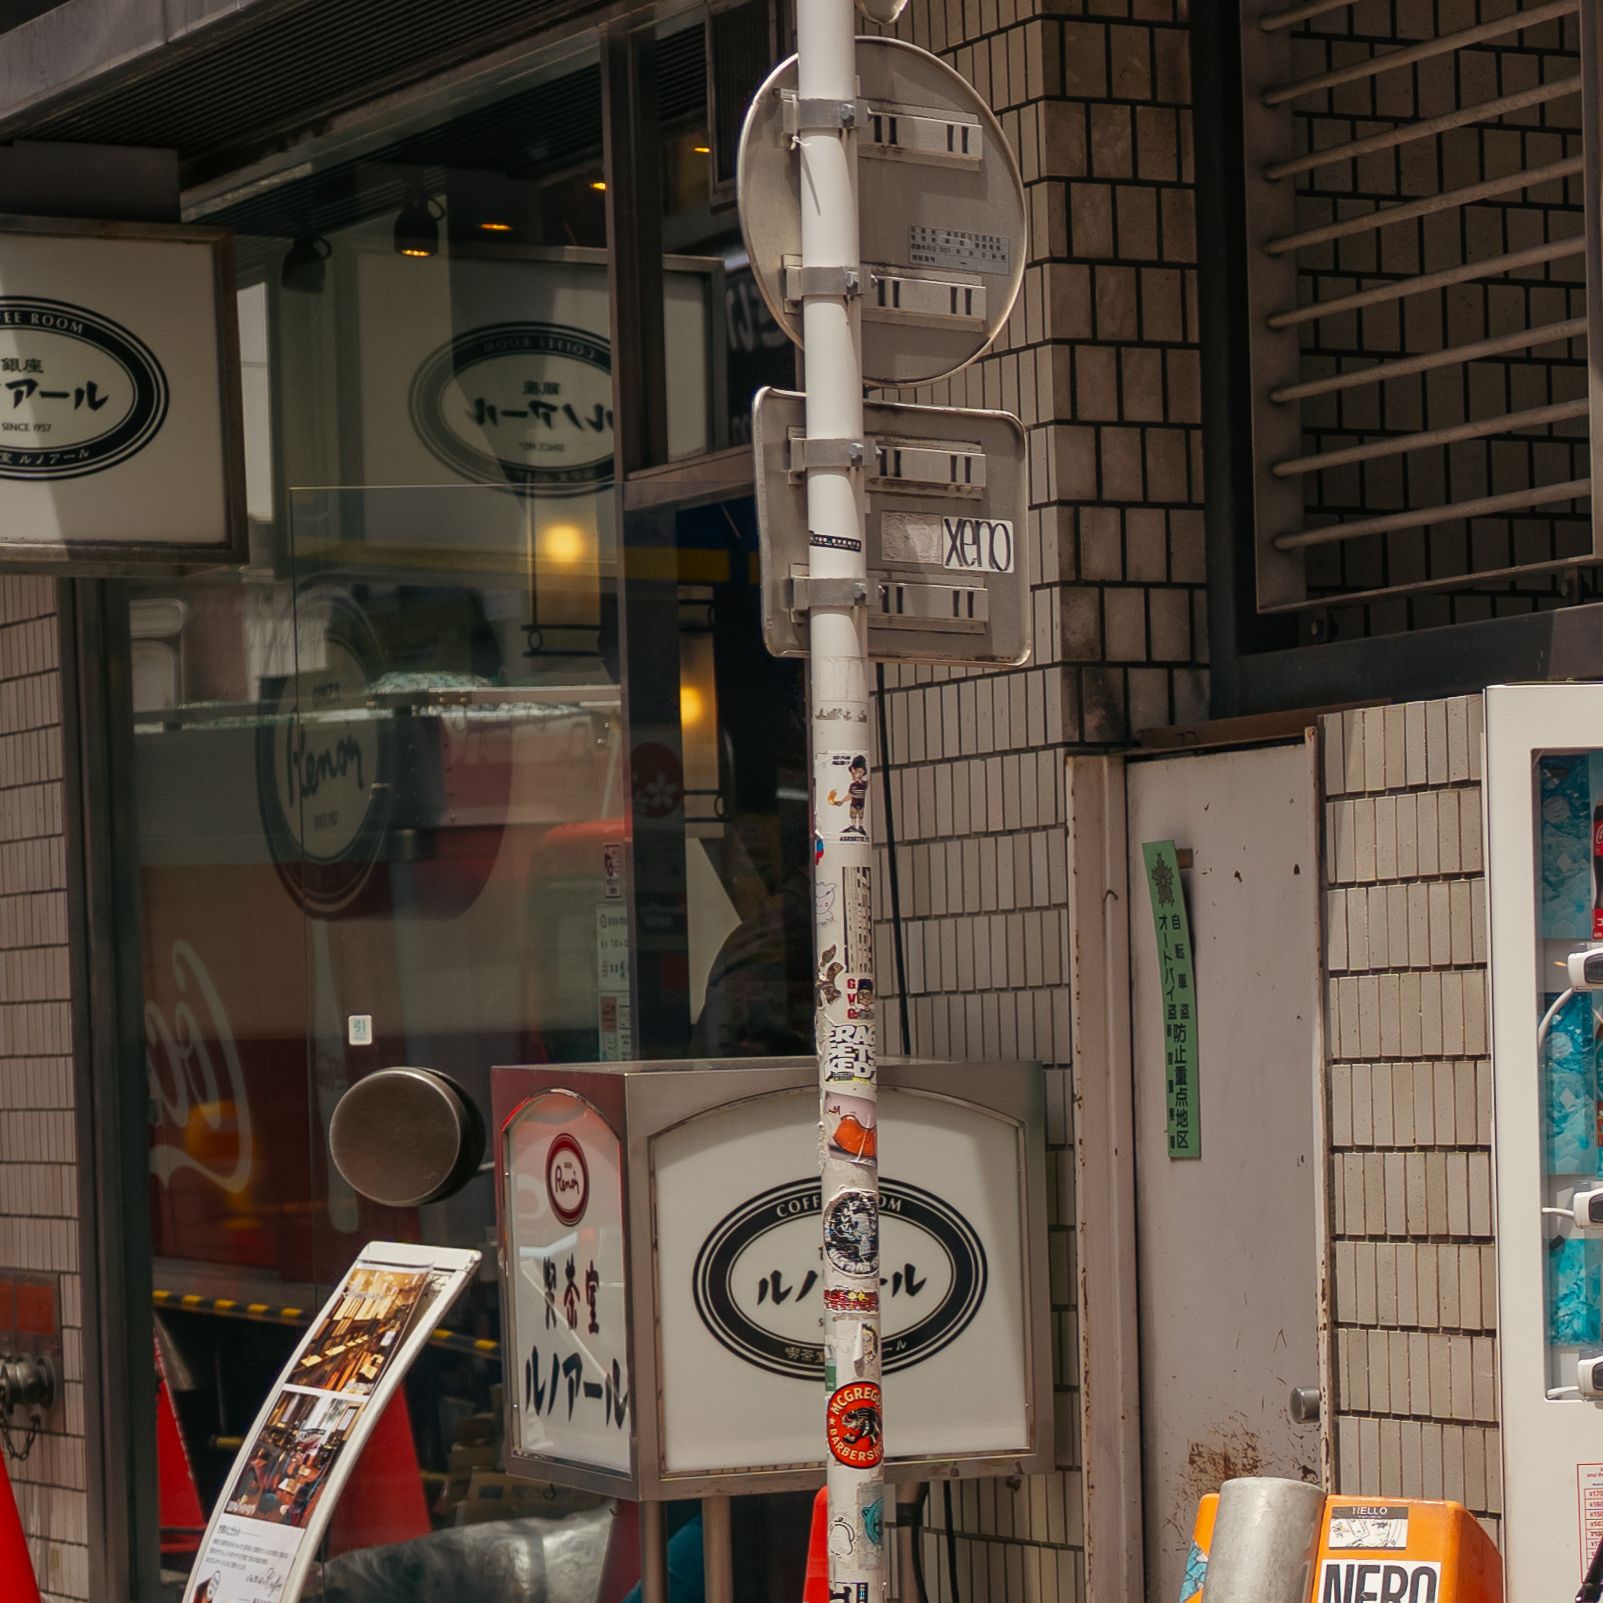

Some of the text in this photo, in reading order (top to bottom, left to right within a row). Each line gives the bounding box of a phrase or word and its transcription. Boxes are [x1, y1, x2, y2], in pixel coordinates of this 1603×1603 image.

[31, 314, 84, 334] ROOM
[1, 358, 44, 374] 銀座
[1, 423, 52, 433] SINCE 1957
[525, 1345, 628, 1430] ルノアール
